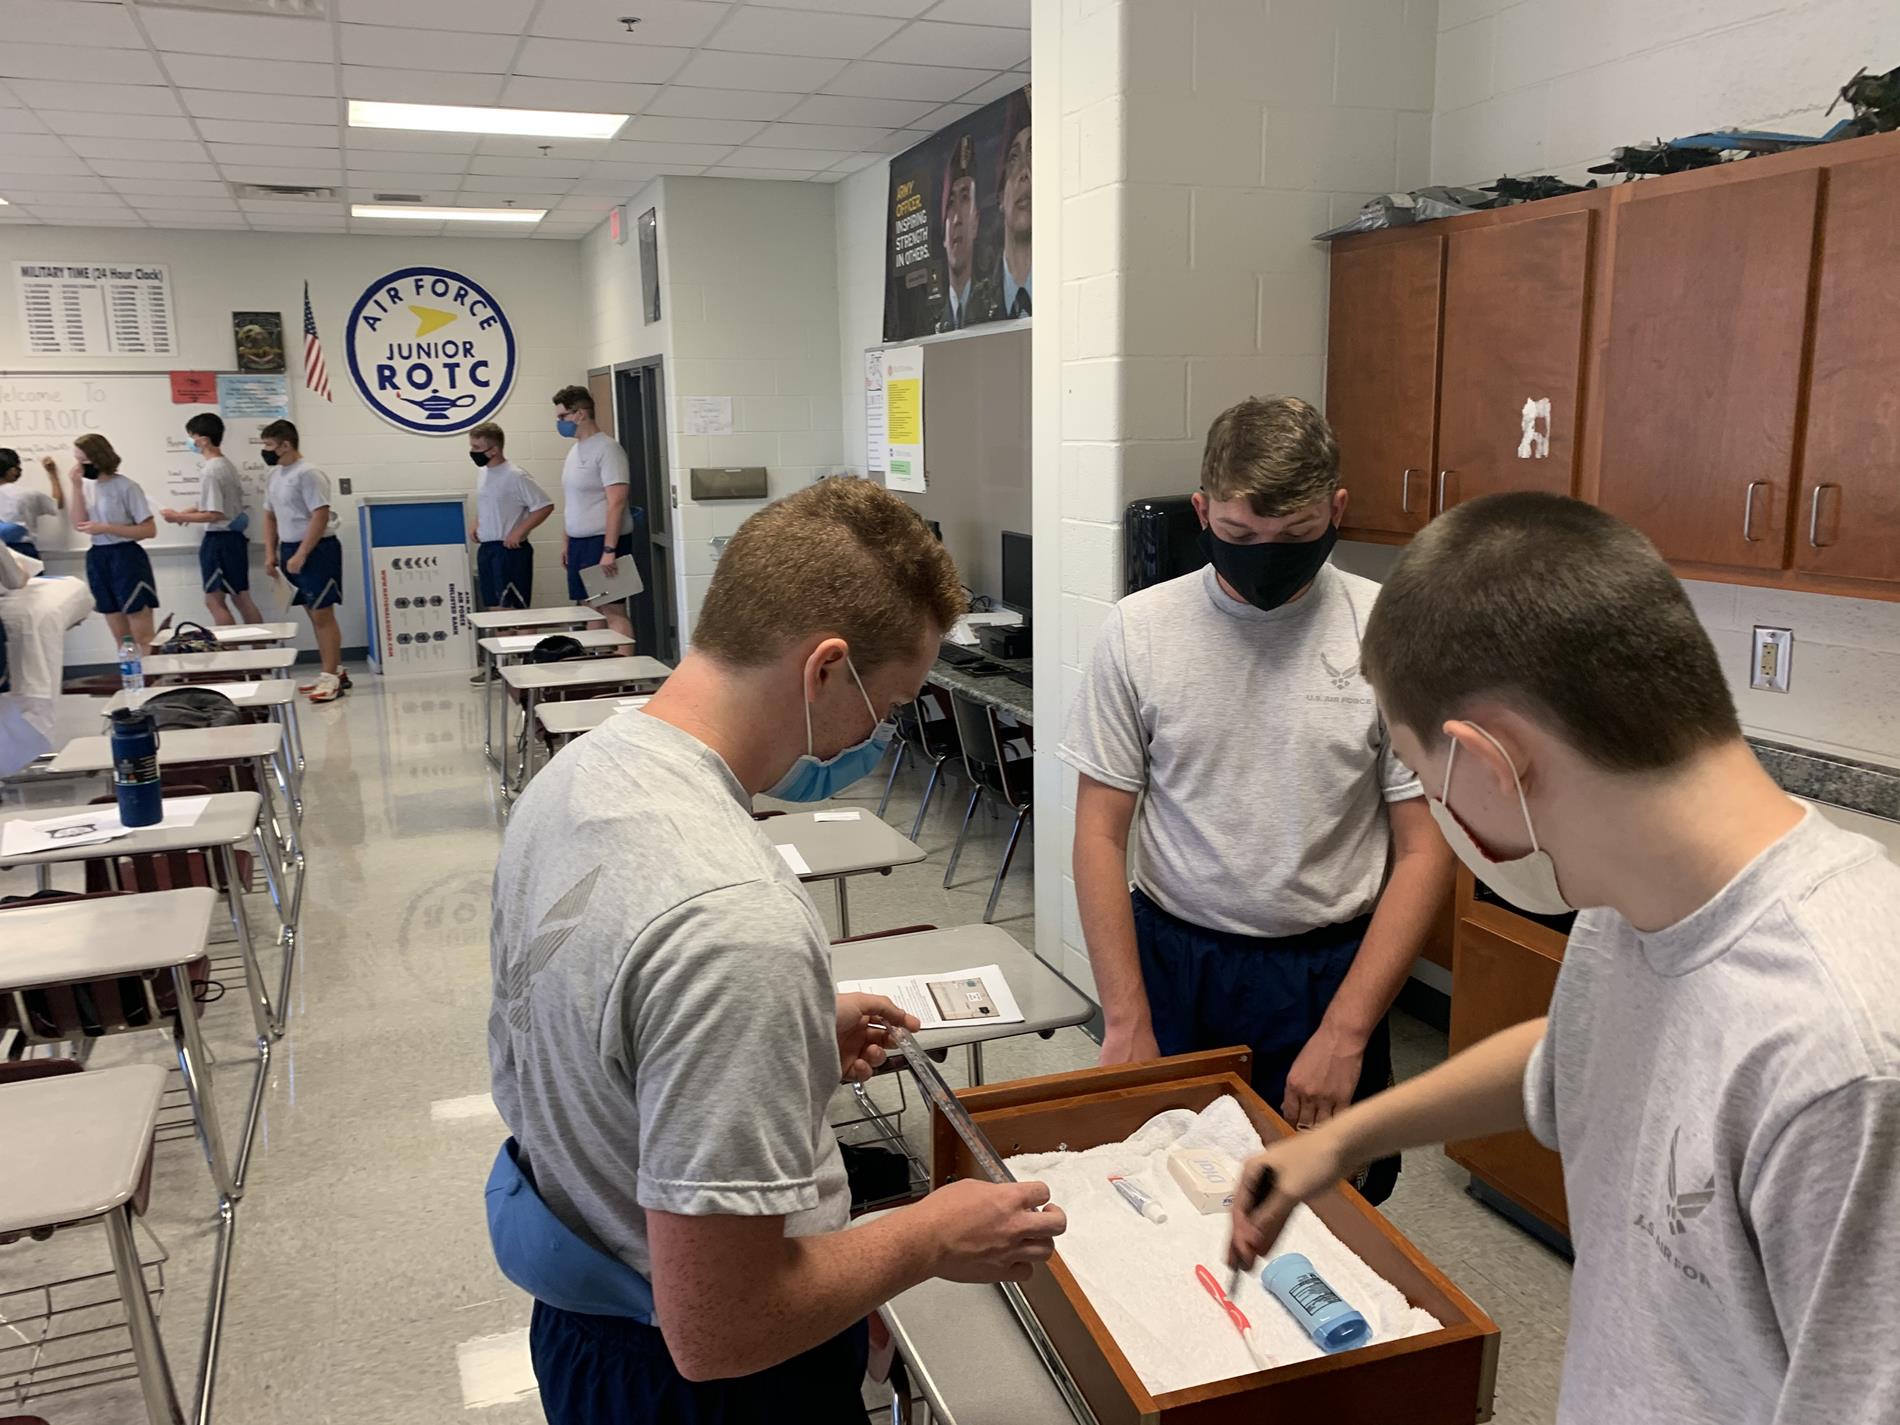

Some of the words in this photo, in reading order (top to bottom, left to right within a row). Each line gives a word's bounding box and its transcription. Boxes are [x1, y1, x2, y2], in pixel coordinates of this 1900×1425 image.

[896, 209, 927, 234] INSPIRING
[896, 226, 928, 251] STRENGTH
[896, 253, 904, 268] IN
[21, 266, 64, 279] MILITARY
[67, 267, 89, 279] TIME
[92, 267, 107, 281] (24
[110, 269, 132, 280] Hour
[135, 268, 163, 282] Clock)
[362, 286, 404, 332] AIR
[414, 278, 498, 331] FORCE
[386, 340, 475, 360] JUNIOR
[377, 360, 490, 390] ROTC
[82, 382, 106, 402] To
[2, 409, 100, 432] AFJROTC
[449, 584, 457, 614] ENLISTED
[381, 570, 394, 657] WWW.NATIONALGUARD.COM
[1655, 1235, 1673, 1263] AIR
